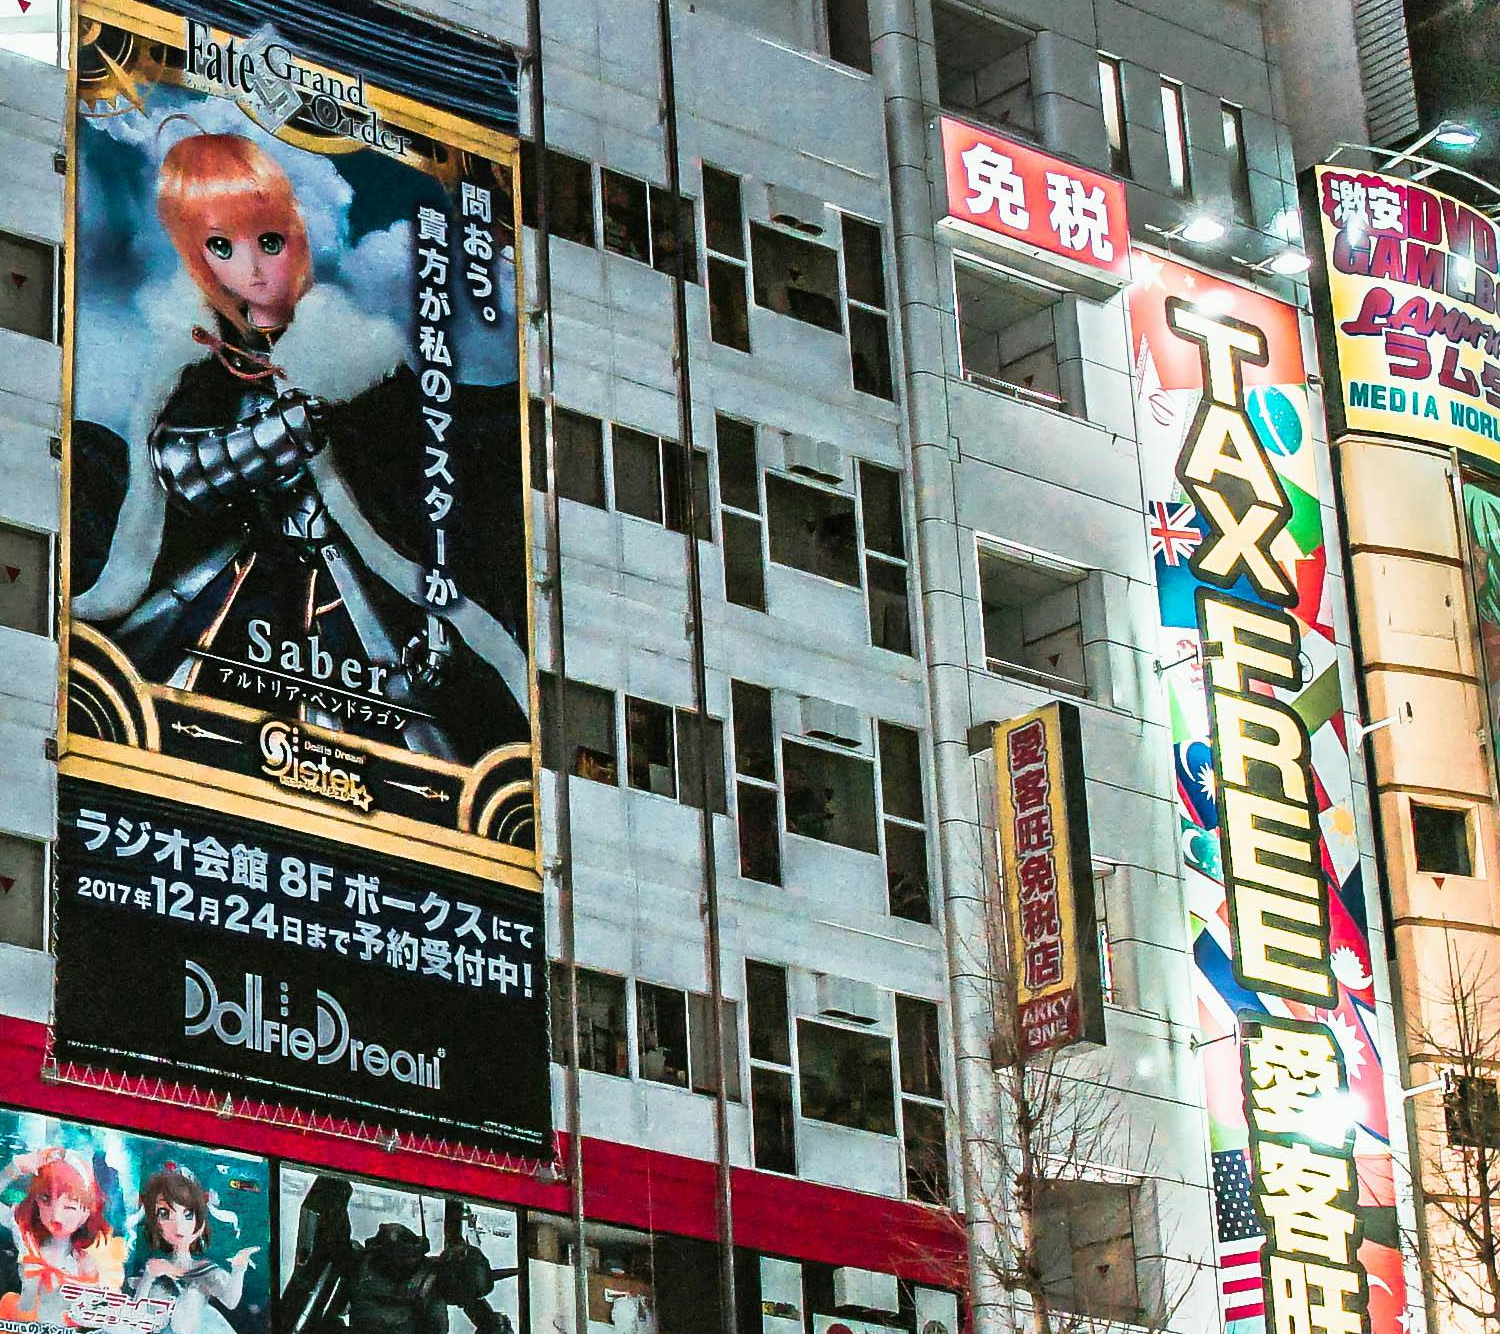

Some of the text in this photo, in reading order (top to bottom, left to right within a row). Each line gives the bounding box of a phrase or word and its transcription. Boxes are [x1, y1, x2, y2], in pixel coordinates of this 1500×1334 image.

[183, 16, 255, 95] Fate
[258, 44, 368, 110] Grand
[309, 94, 413, 158] Order
[962, 144, 1116, 263] 免税
[1332, 177, 1498, 273] 激安 DVD
[460, 180, 497, 324] 問おう。
[1347, 379, 1441, 422] MEDIA
[247, 617, 391, 698] Saber
[1173, 315, 1335, 999] TAX FREE
[217, 666, 407, 731] アルトリア・ペンドラゴン
[259, 719, 362, 796] Sister
[76, 808, 535, 949] ラジオ会館 8F ボークスにて
[1006, 721, 1064, 991] 愛客旺免税店
[76, 873, 535, 999] 2017年12月24日まで予約受付中!
[1026, 1015, 1072, 1051] ONE
